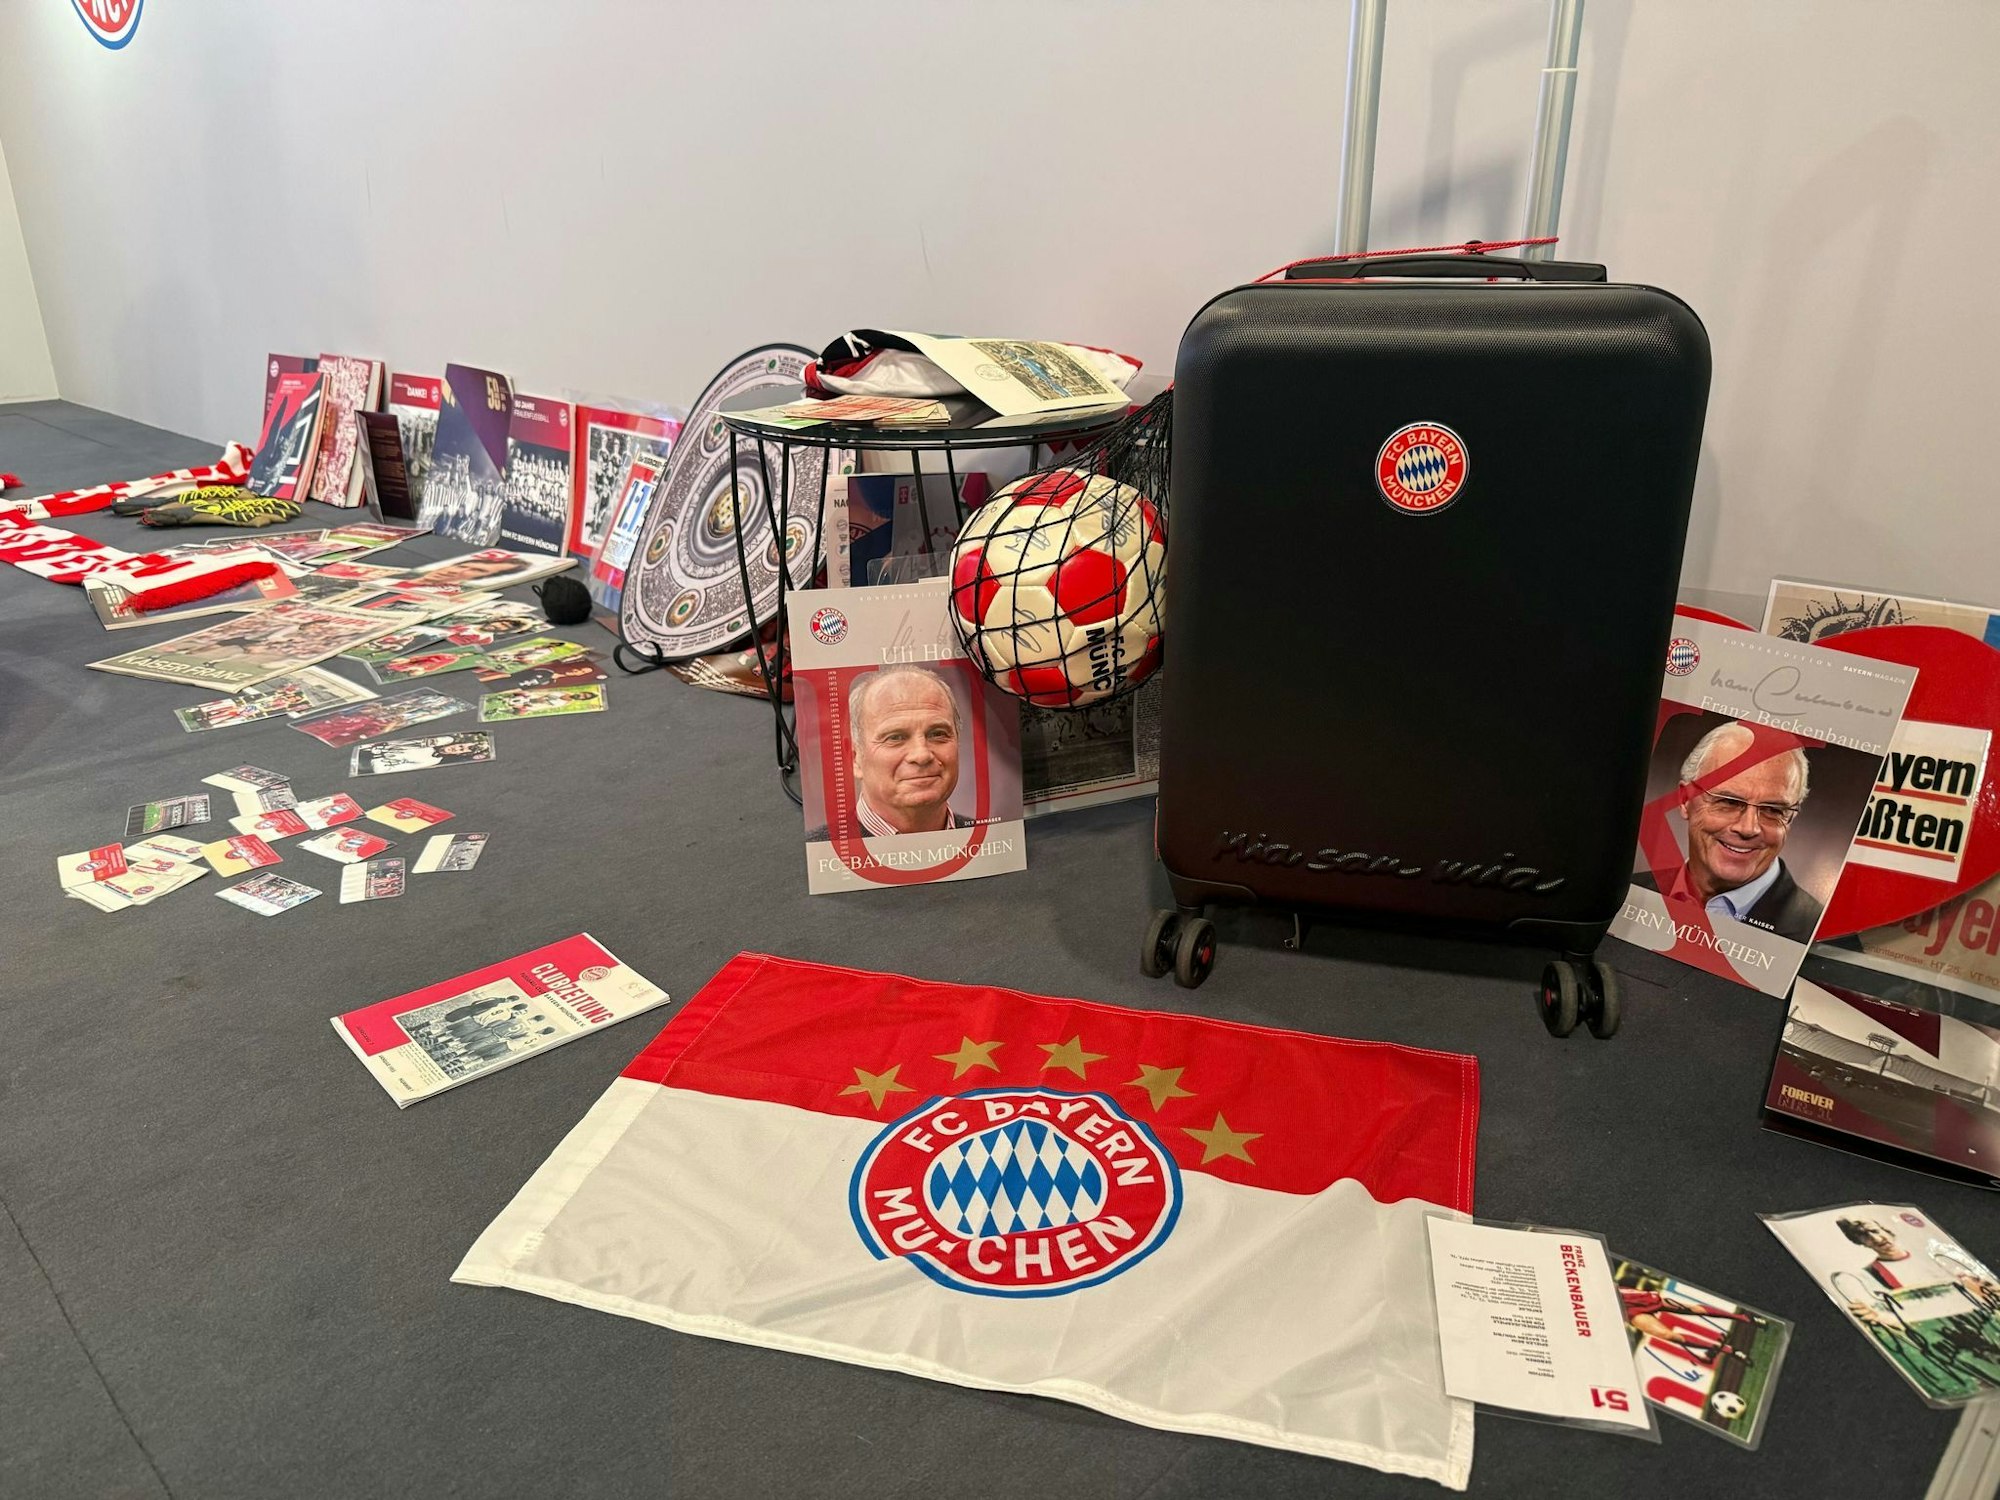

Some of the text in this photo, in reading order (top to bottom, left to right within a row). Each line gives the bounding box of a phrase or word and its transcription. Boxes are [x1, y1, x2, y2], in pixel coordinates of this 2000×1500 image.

[1385, 430, 1461, 466] FC BAYERN
[1383, 474, 1457, 507] MÜNCHEN
[882, 643, 965, 665] Uli Hoe
[1086, 627, 1112, 691] MÜNC
[1723, 638, 1833, 668] SONDEREDITION
[1700, 695, 1882, 755] Franz Beckenbauer
[818, 838, 1015, 873] FC BAYERN MÜNCHEN
[1748, 917, 1776, 932] KAISER
[1666, 920, 1776, 971] MÜNCHEN
[531, 963, 614, 1024] CLUBZEITUNG
[1781, 1084, 1834, 1111] FOREVER
[901, 1100, 1155, 1187] FC BAYERN
[1573, 1245, 1585, 1268] FRANZ
[1560, 1244, 1592, 1338] BECKENBAUER
[1590, 1388, 1630, 1412] 51
